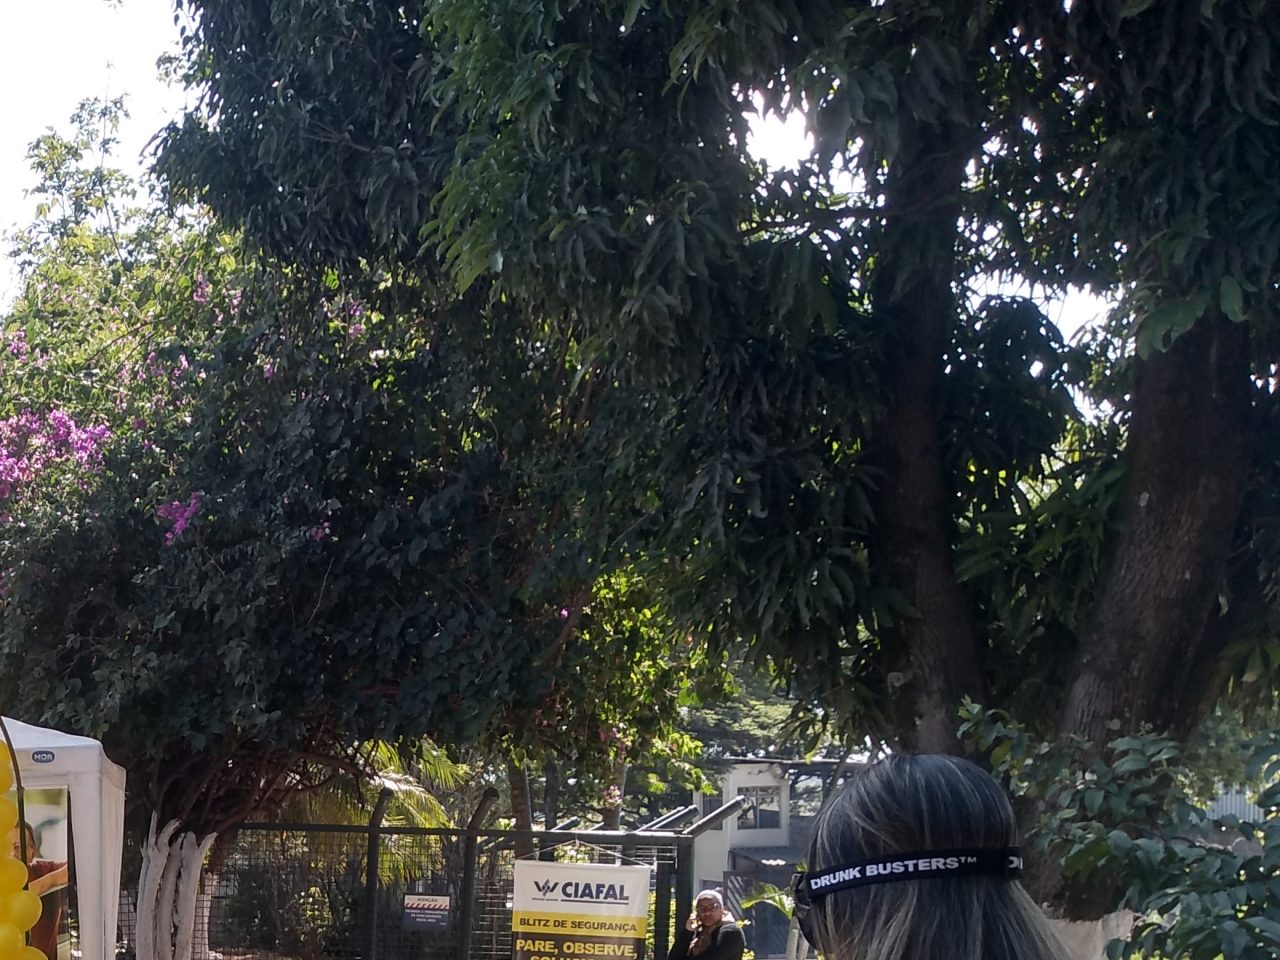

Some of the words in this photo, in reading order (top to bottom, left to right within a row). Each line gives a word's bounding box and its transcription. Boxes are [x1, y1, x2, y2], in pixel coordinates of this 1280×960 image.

[810, 866, 862, 890] DRUNK
[561, 881, 630, 901] CIAFAL
[519, 917, 550, 928] BLITZ
[553, 919, 567, 928] DE
[570, 920, 637, 933] SEGURANÇA
[516, 939, 559, 955] PARE,
[563, 942, 638, 960] OBSERVE,
